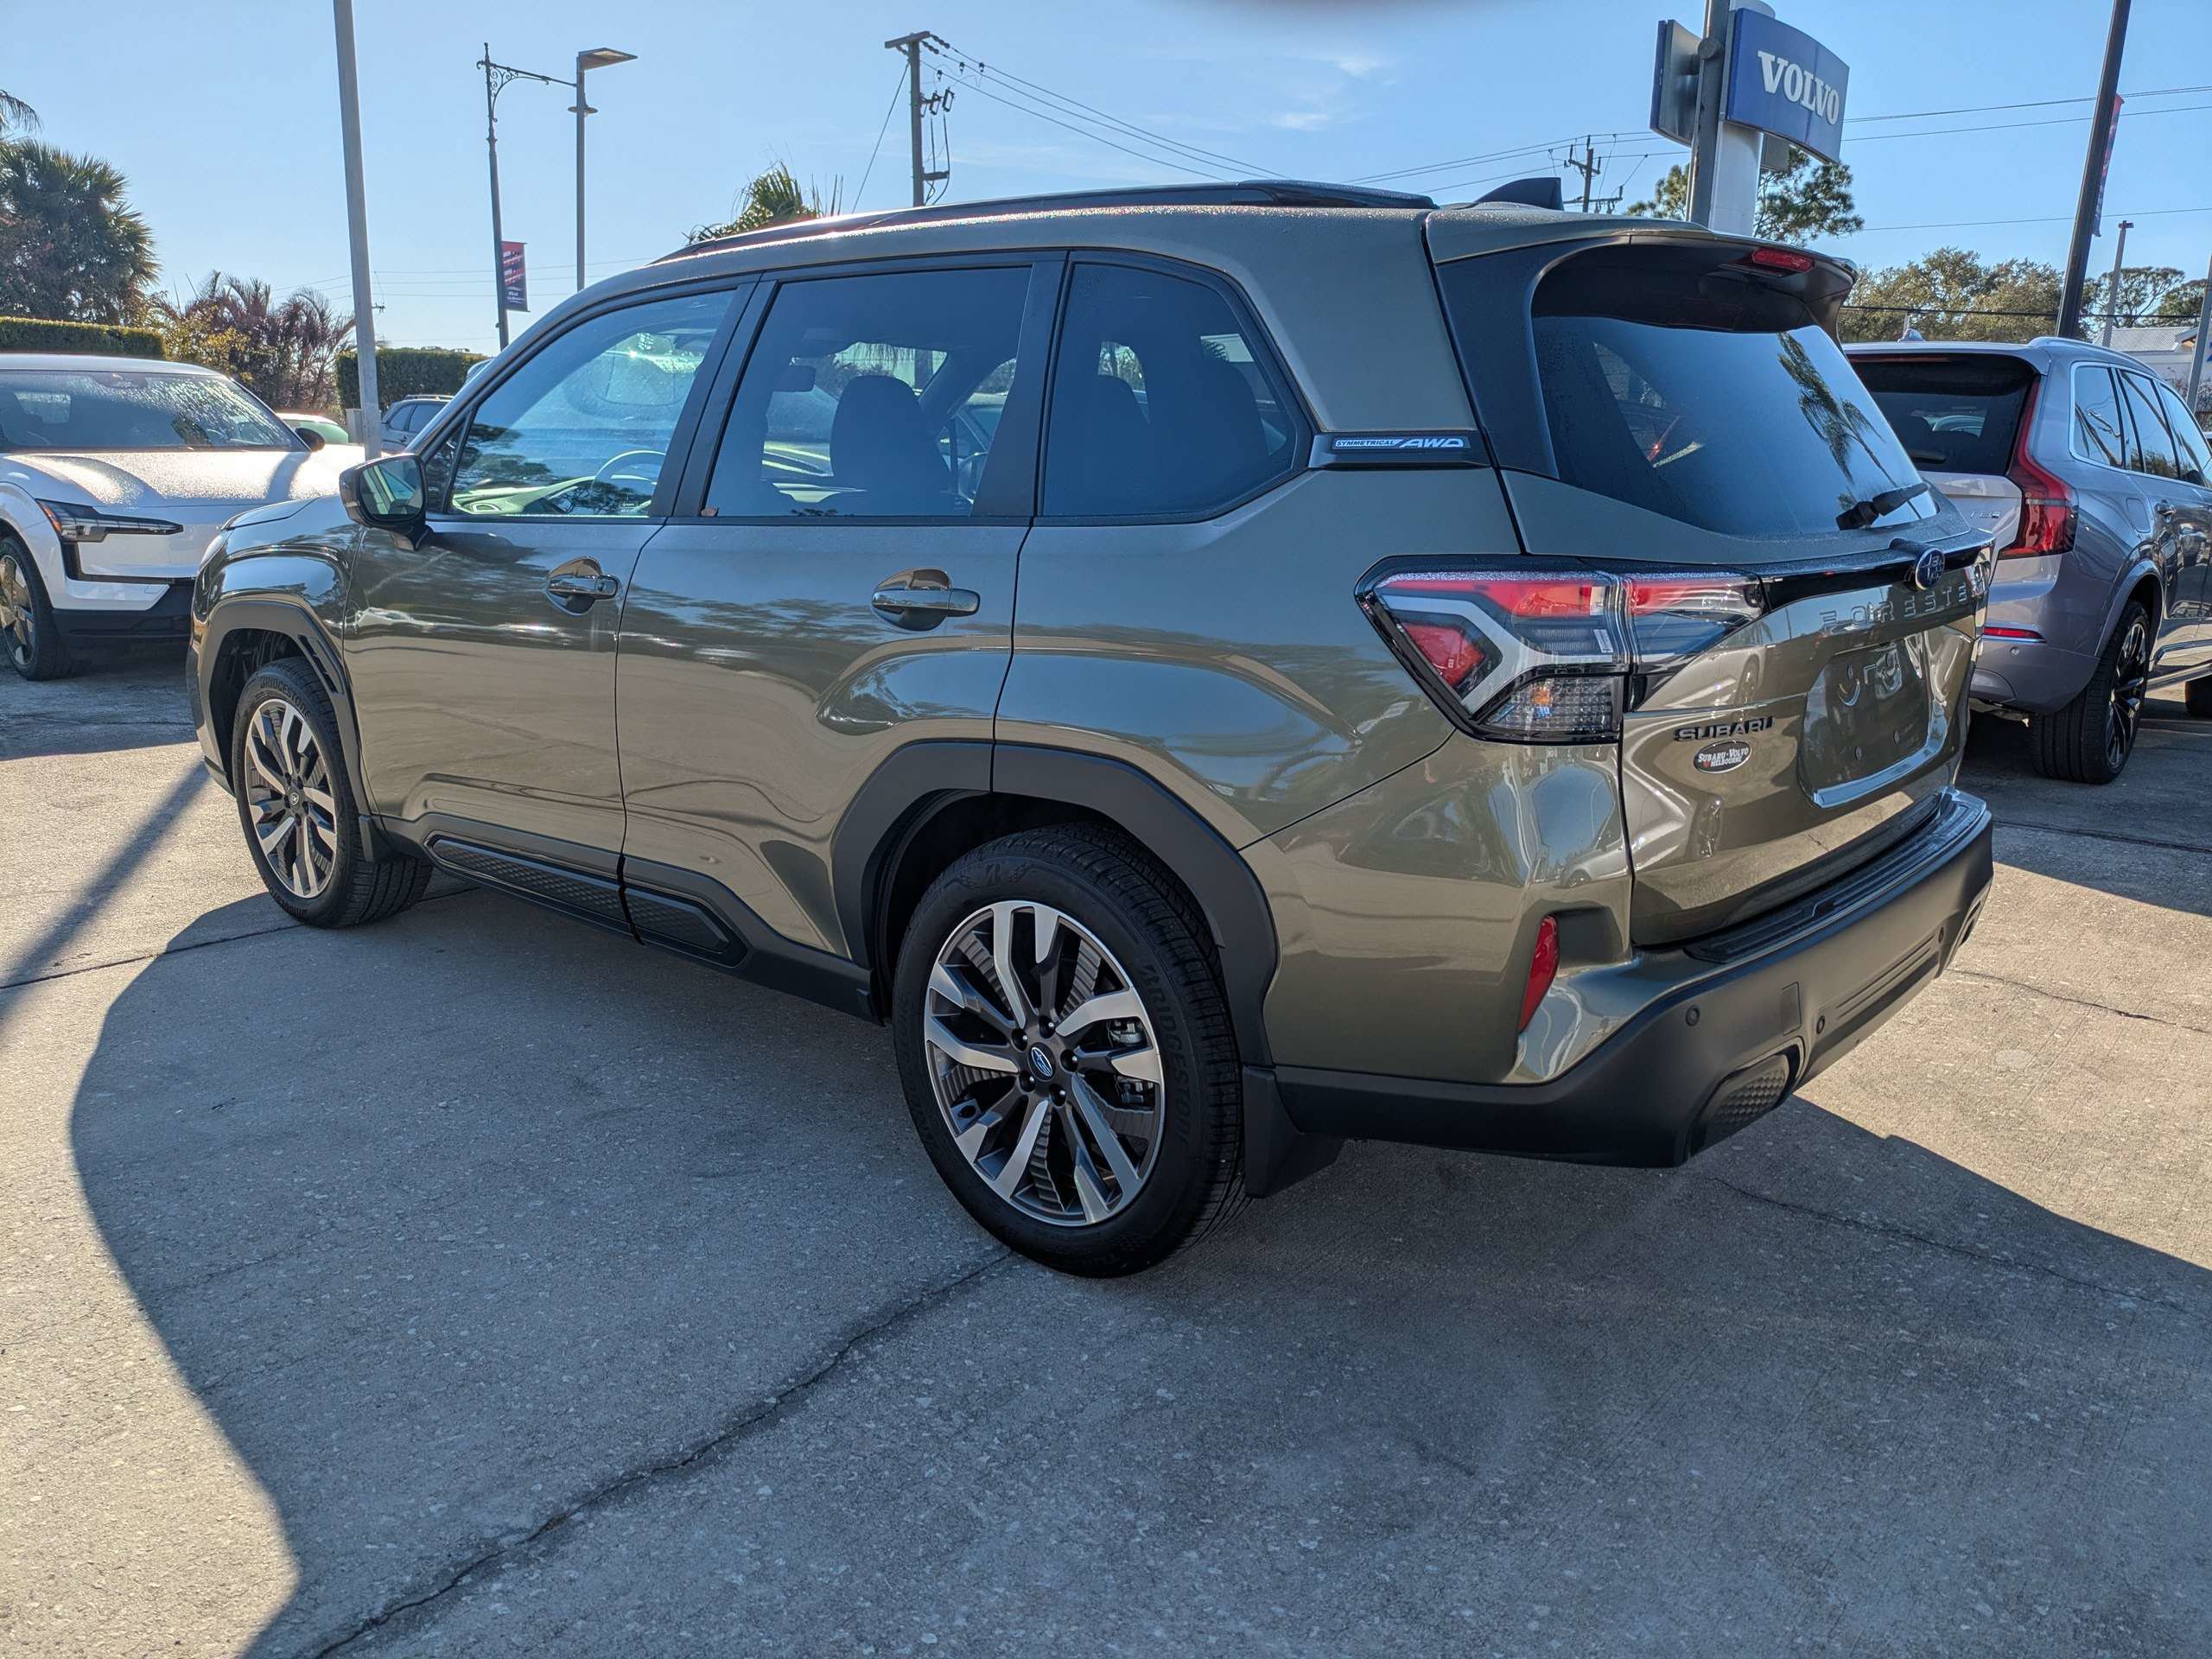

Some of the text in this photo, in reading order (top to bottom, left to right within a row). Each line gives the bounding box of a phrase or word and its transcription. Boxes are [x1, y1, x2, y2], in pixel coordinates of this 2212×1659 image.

[1757, 51, 1840, 125] VOLVO
[1399, 438, 1464, 448] AWD
[1673, 716, 1776, 741] SUBARU
